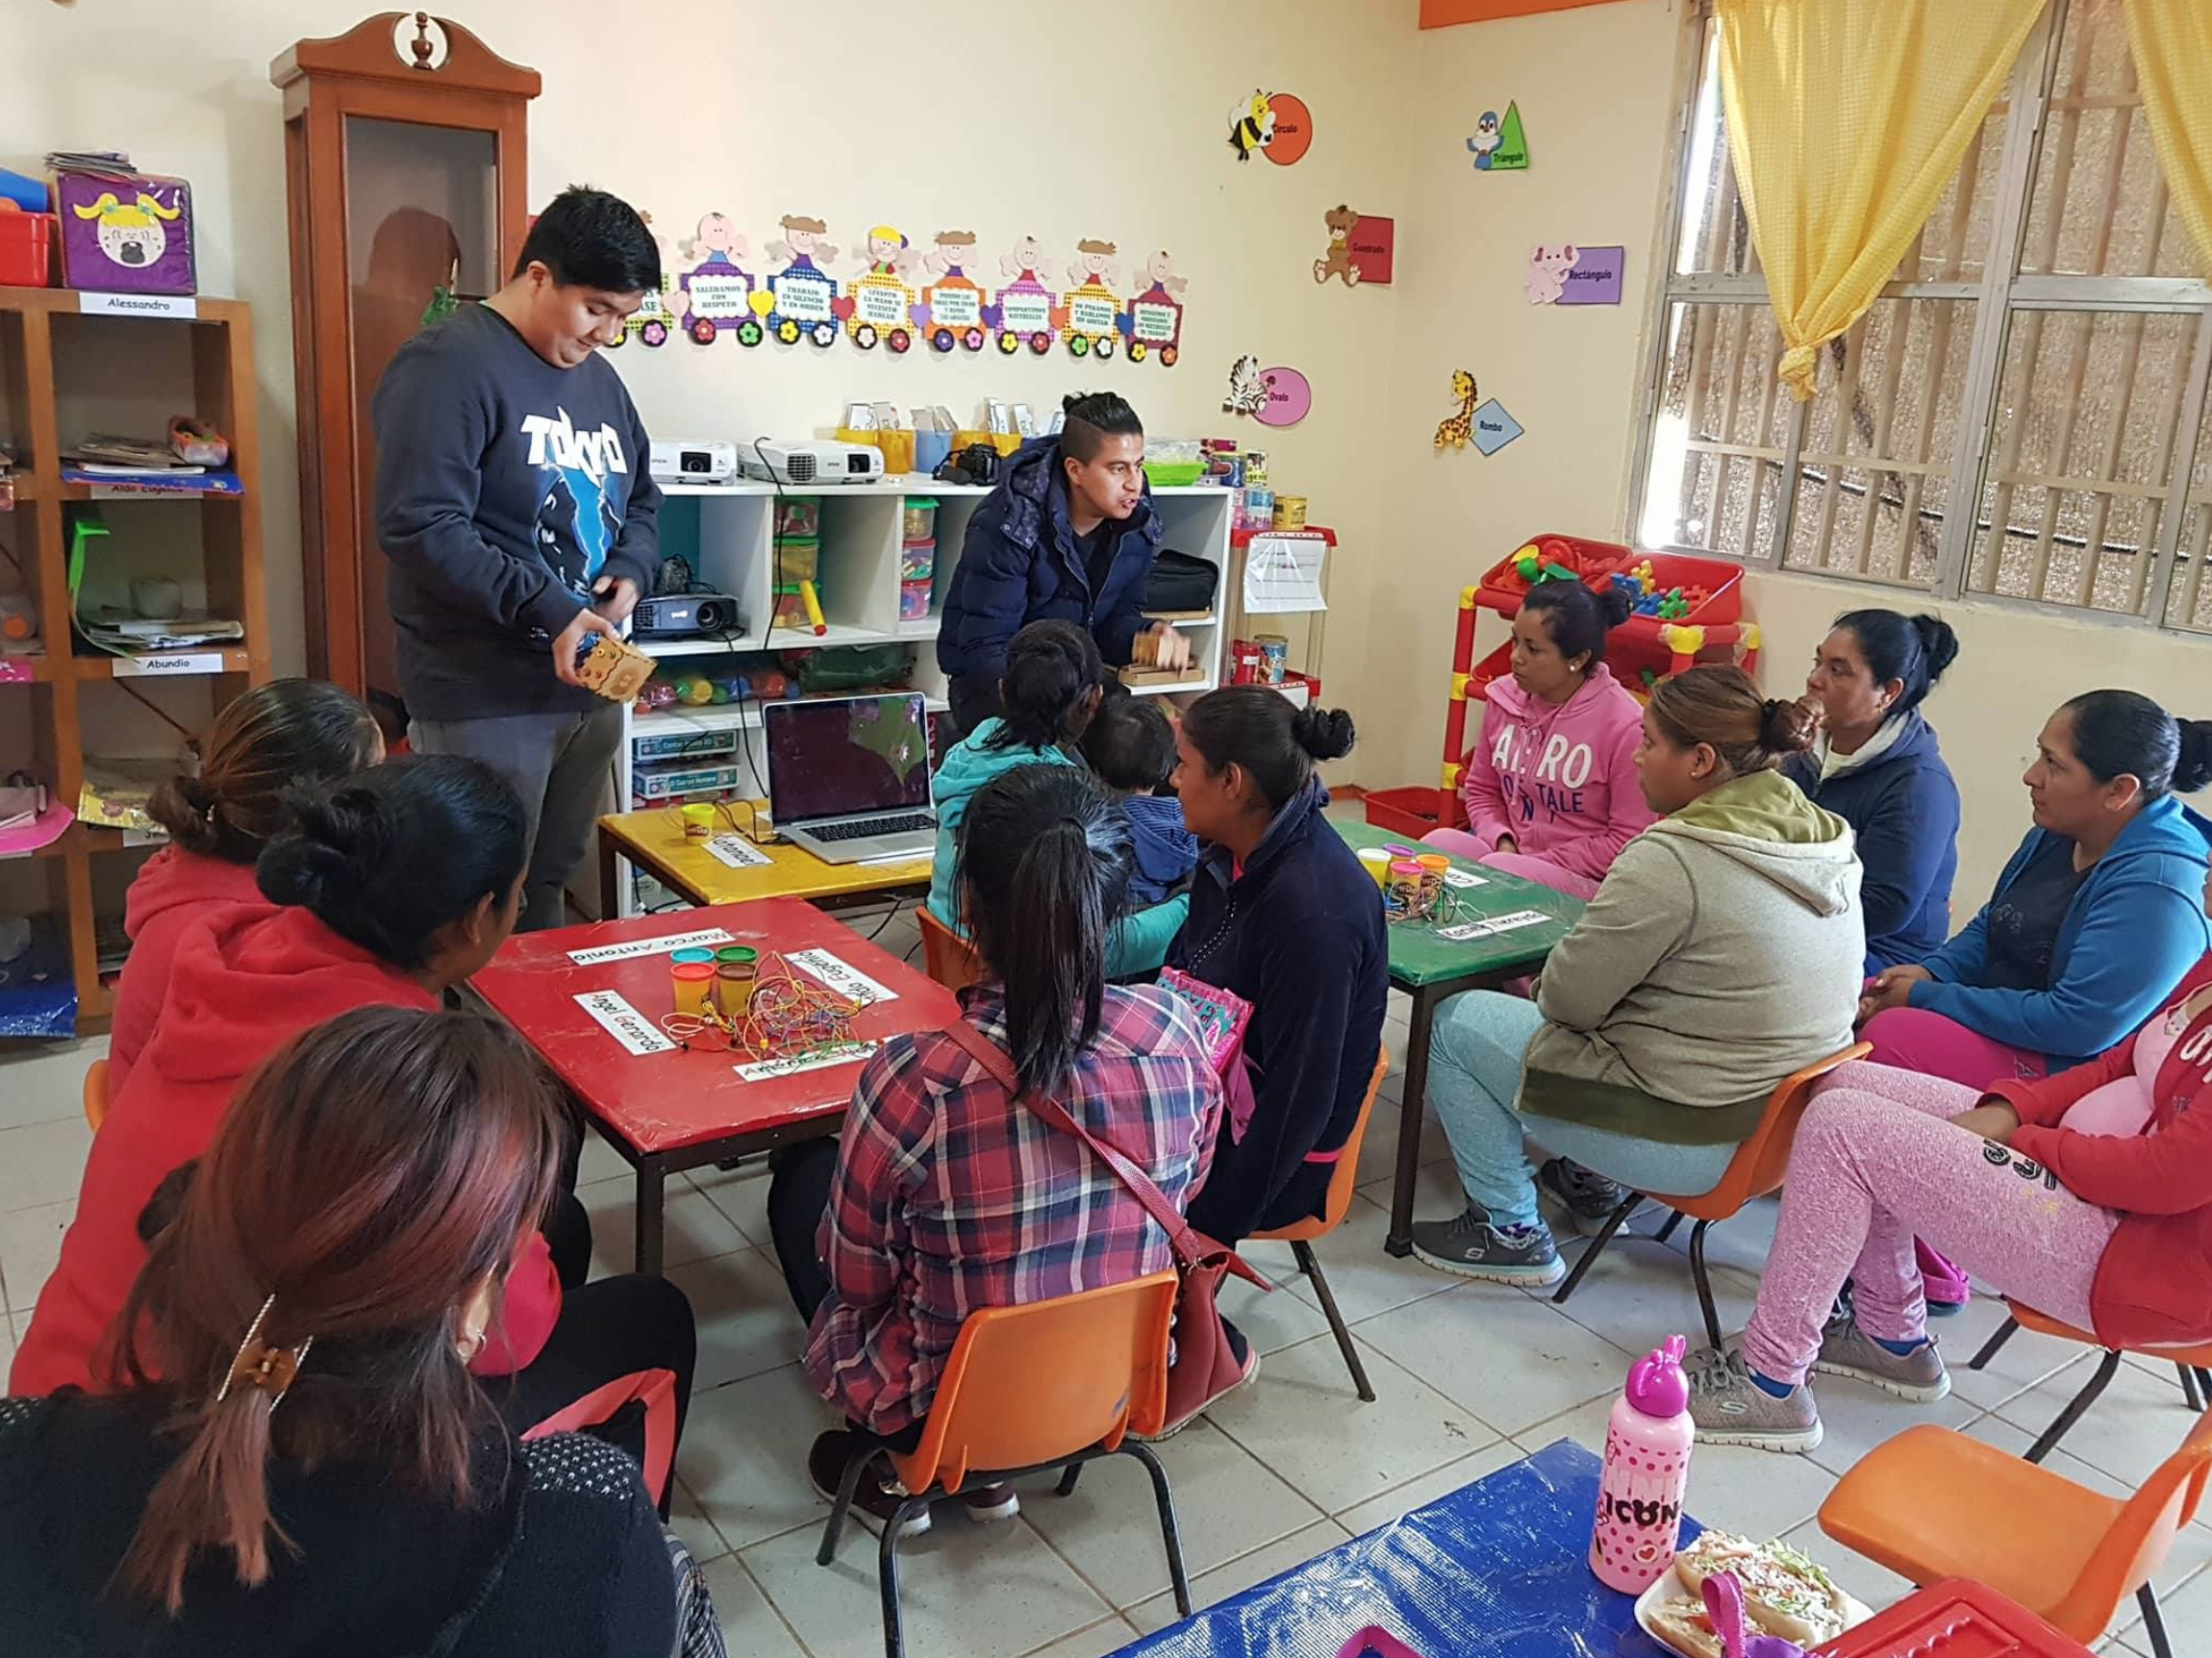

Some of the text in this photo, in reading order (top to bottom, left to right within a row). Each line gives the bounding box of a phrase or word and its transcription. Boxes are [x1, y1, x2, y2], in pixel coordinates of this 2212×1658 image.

[108, 297, 170, 311] Alessandro
[520, 405, 628, 490] TOKYO
[146, 660, 190, 669] Abundio
[664, 931, 728, 946] Marco
[614, 1016, 663, 1052] Gerardo
[1603, 1490, 1679, 1527] ICON
